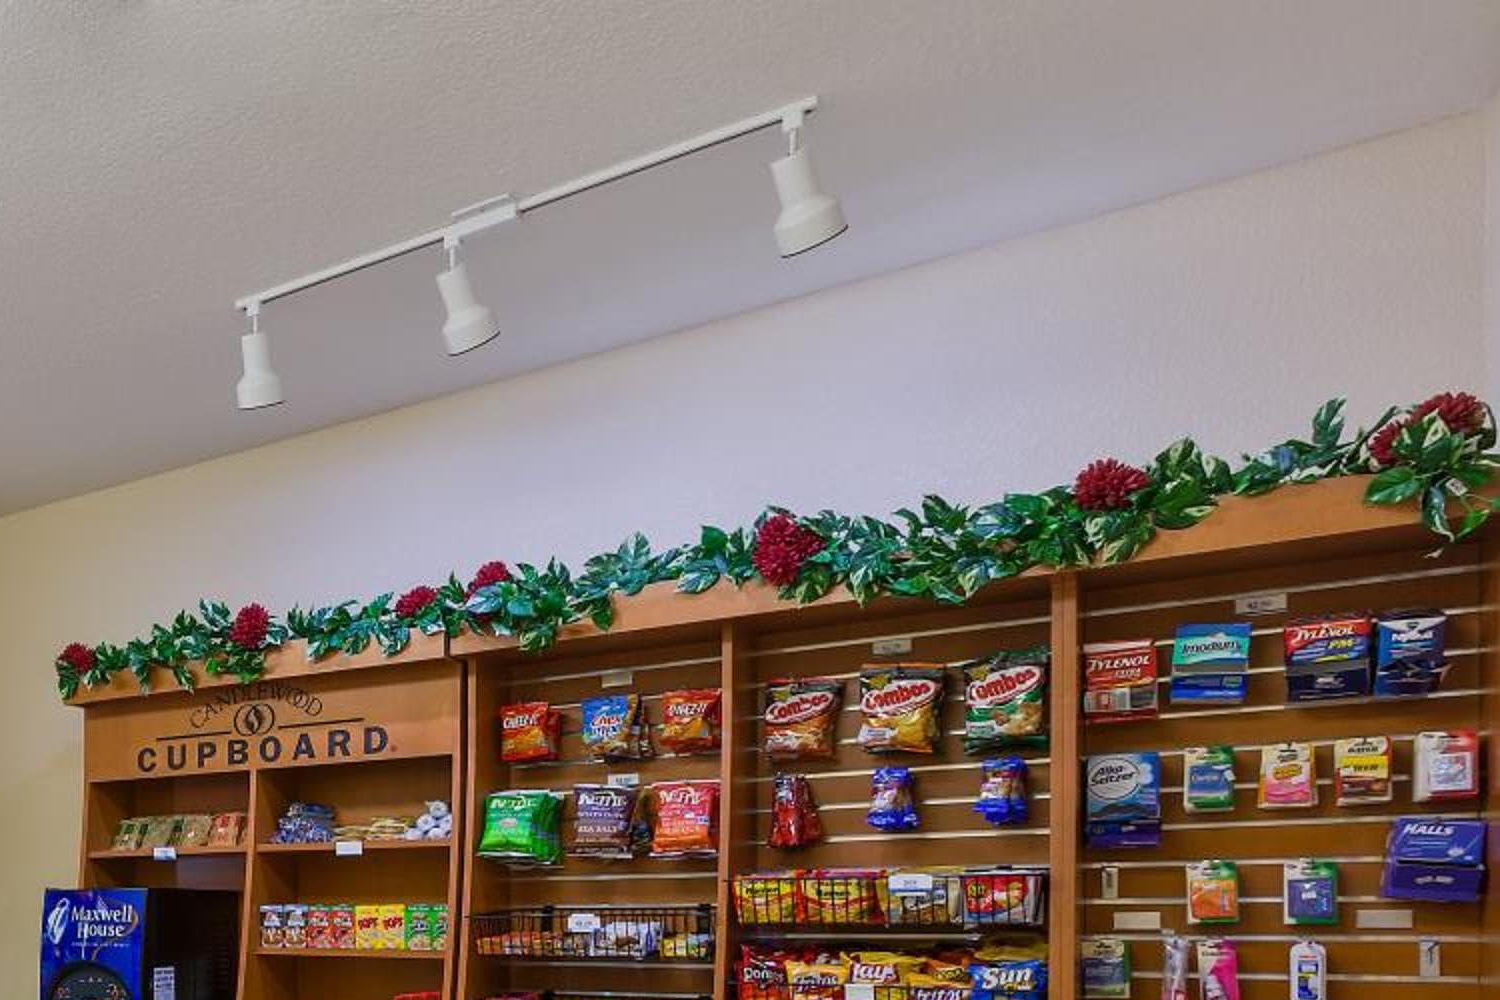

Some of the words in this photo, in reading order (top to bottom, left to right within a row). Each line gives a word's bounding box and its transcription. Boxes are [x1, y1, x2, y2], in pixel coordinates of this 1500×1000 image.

[1296, 624, 1355, 640] TYLENOL
[1181, 639, 1241, 657] Imodium
[1090, 655, 1150, 672] TYLENOL
[865, 683, 931, 711] Combos
[189, 684, 323, 729] CANDLEWOOD
[138, 726, 389, 772] CUPBOARD
[1403, 823, 1455, 836] HALLS
[71, 904, 134, 923] Maxwell
[77, 922, 126, 939] House
[982, 967, 1033, 991] Sun
